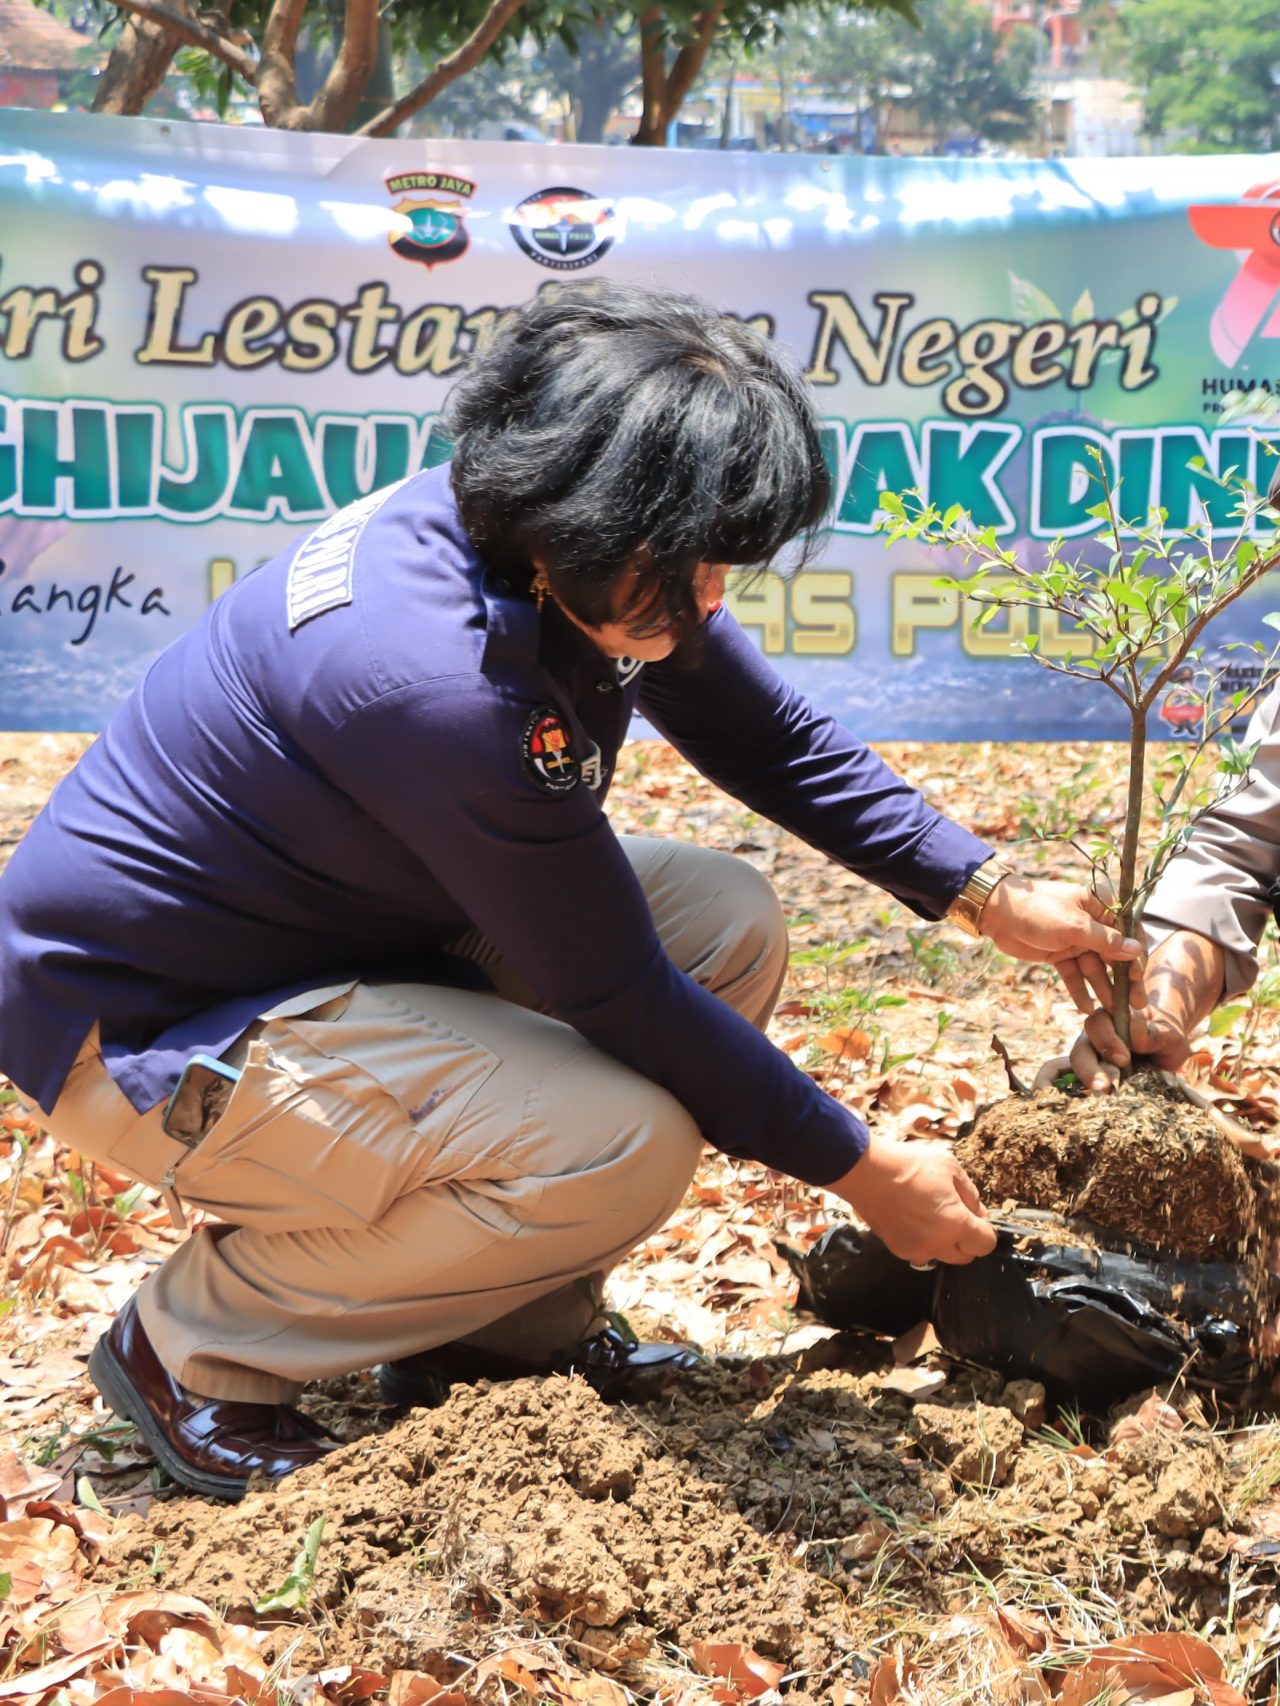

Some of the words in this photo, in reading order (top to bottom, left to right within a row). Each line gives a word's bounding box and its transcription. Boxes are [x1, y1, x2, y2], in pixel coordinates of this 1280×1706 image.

[390, 175, 438, 190] METRO
[440, 176, 473, 195] JAYA
[0, 258, 105, 362] ri
[803, 290, 1167, 417] Negeri
[5, 565, 171, 646] angka
